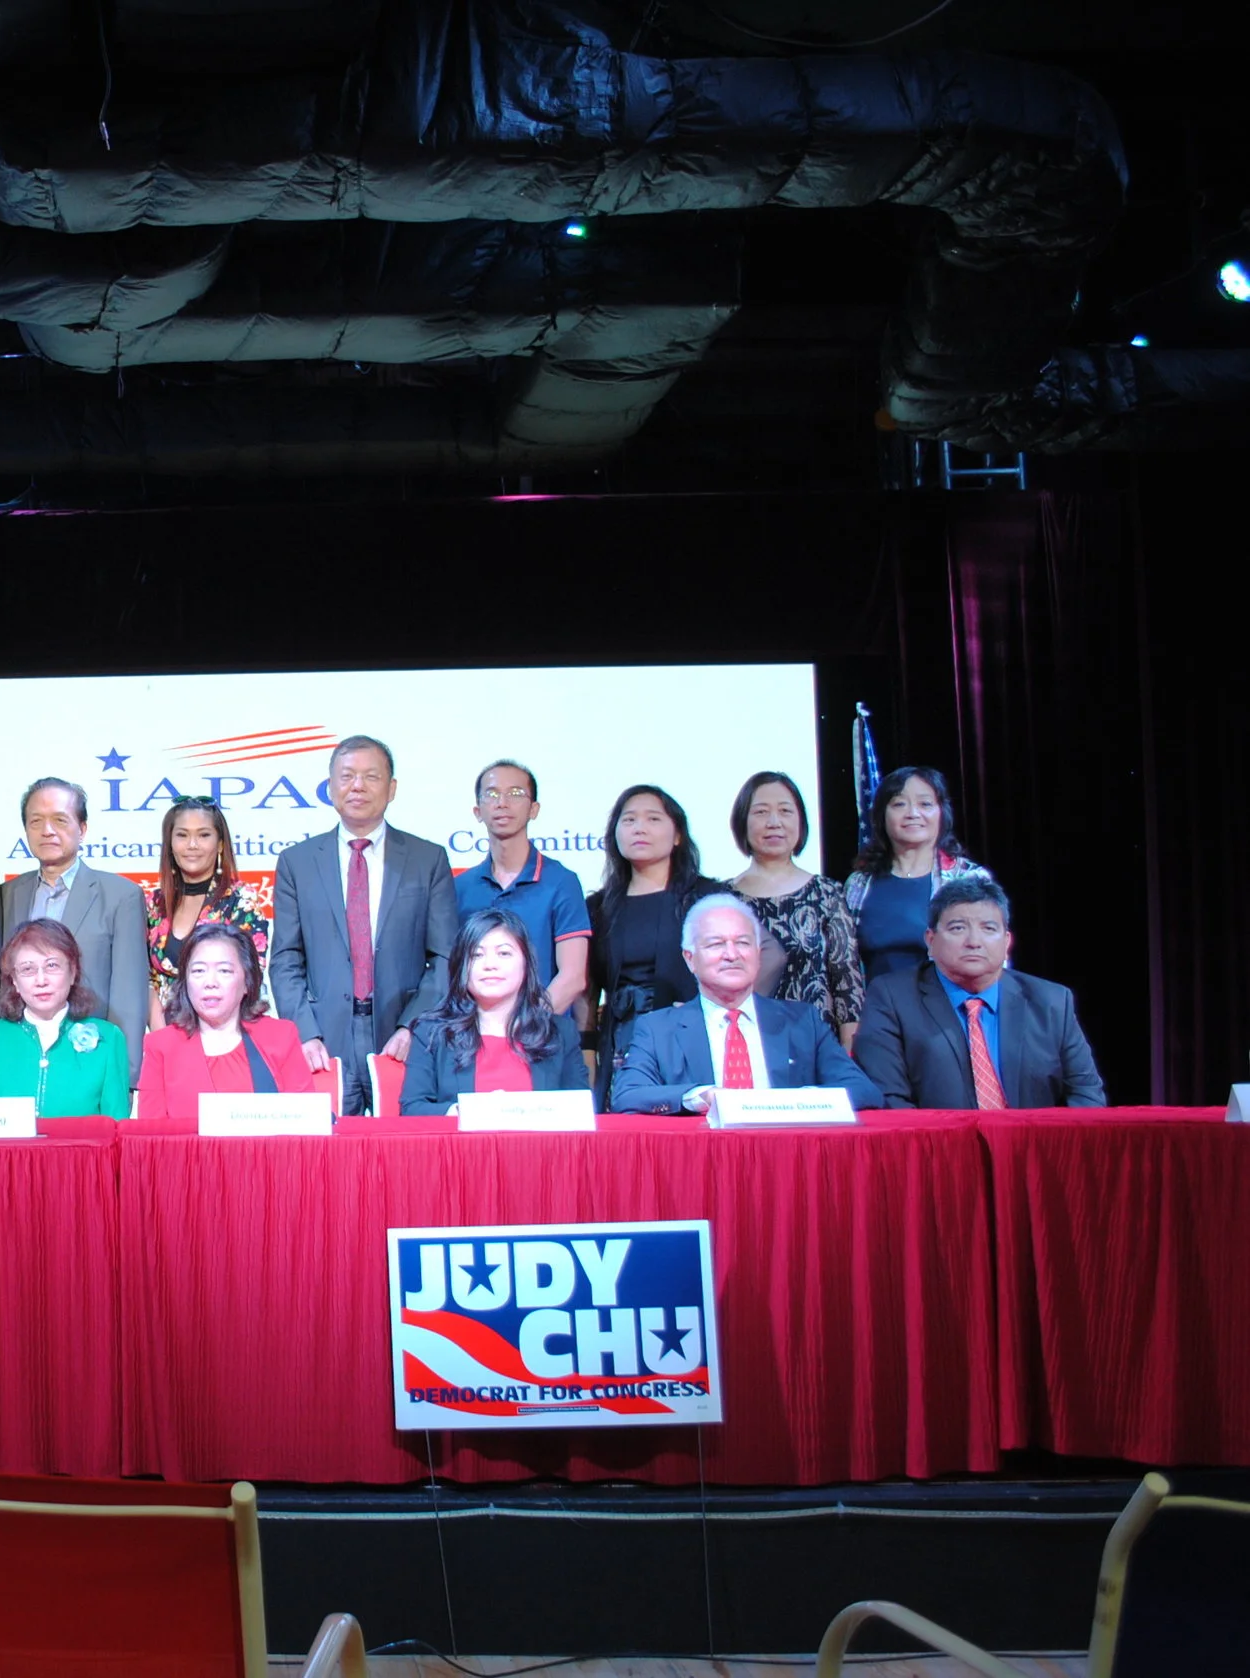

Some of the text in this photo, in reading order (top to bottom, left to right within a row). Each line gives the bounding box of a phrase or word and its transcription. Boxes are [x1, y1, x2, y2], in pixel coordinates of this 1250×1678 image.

[7, 836, 161, 860] Aerican
[405, 1238, 631, 1312] JUDY
[518, 1305, 701, 1380] CHU
[409, 1380, 707, 1404] DEMOCRAT FOR CONGRESS
